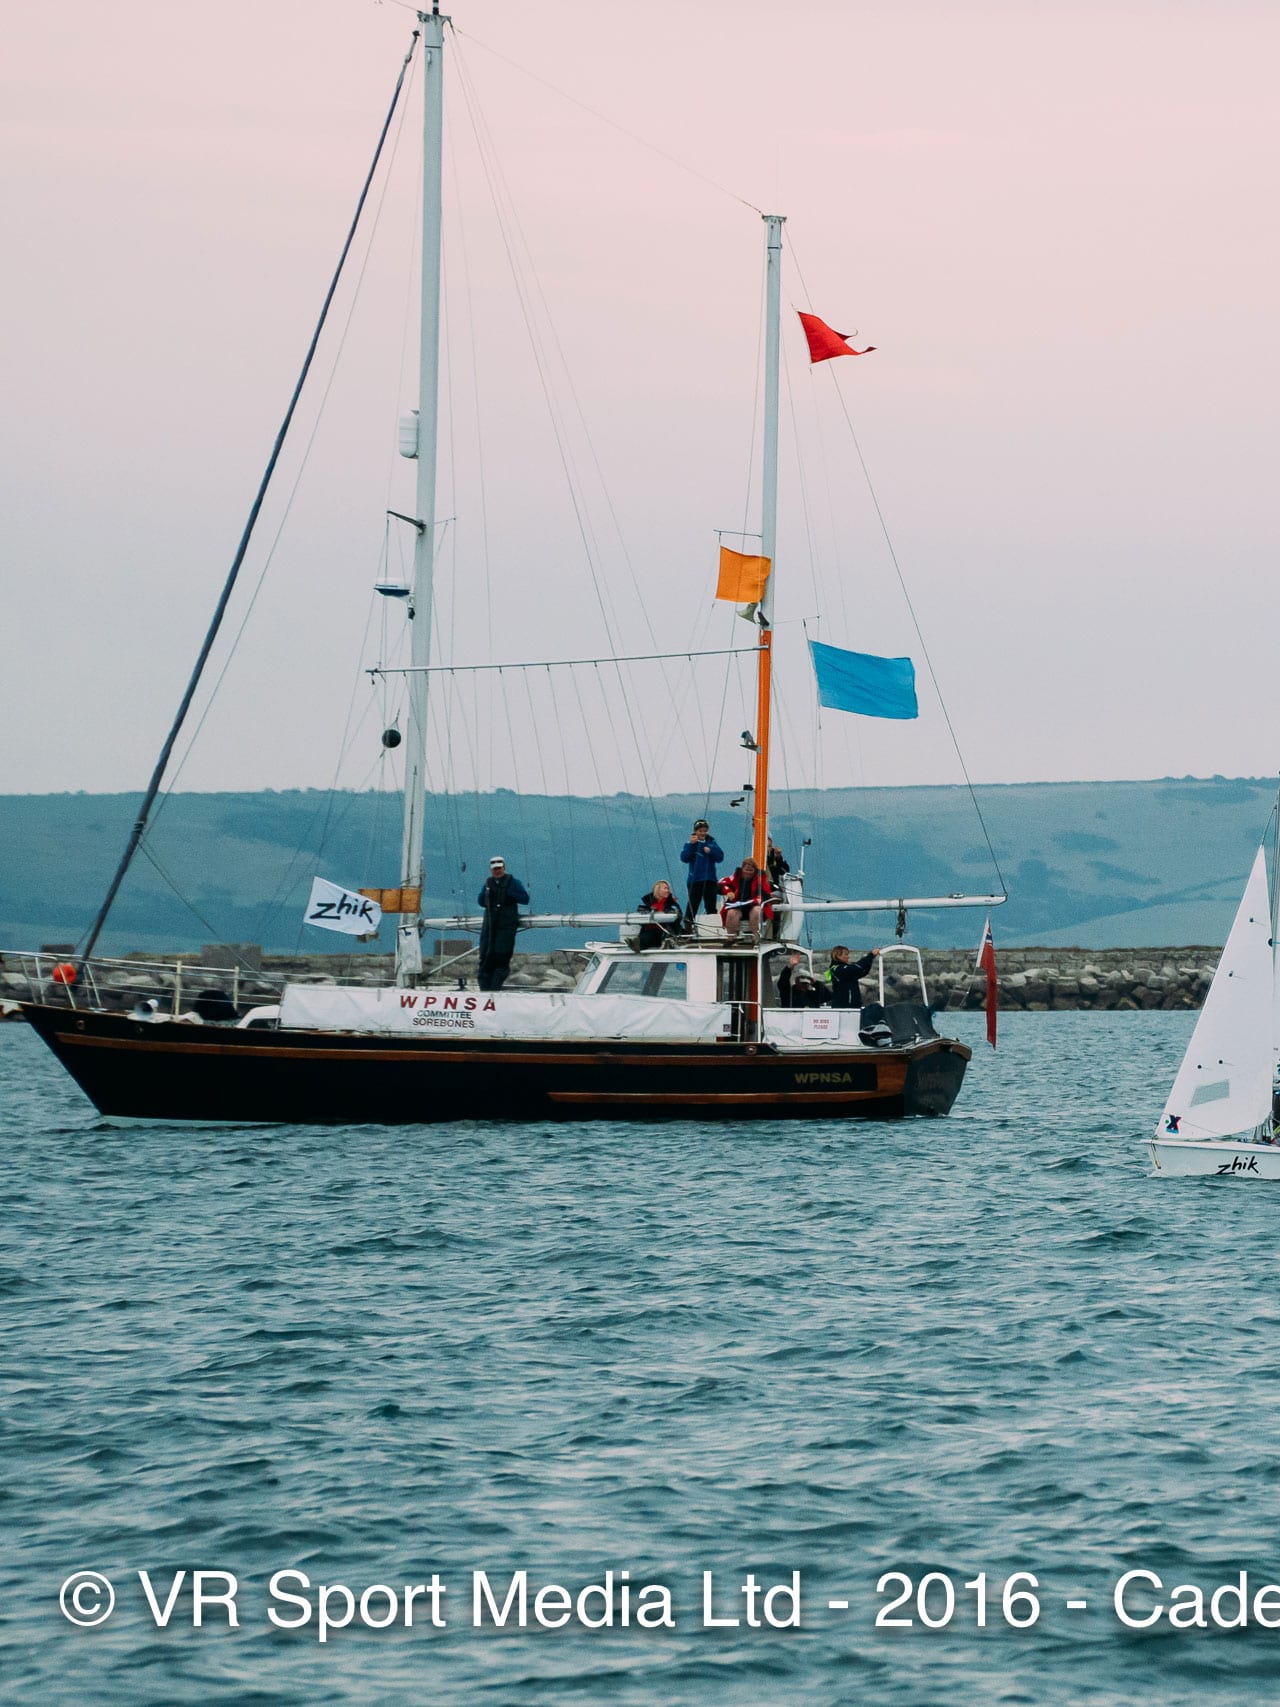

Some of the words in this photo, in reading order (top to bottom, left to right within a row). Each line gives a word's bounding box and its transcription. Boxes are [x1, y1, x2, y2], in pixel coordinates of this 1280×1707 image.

[309, 893, 374, 925] zhik
[417, 1009, 472, 1020] COMMITTEE
[412, 1017, 475, 1029] SOREBONES
[794, 1072, 853, 1084] WPNSA
[1216, 1155, 1260, 1175] zhik
